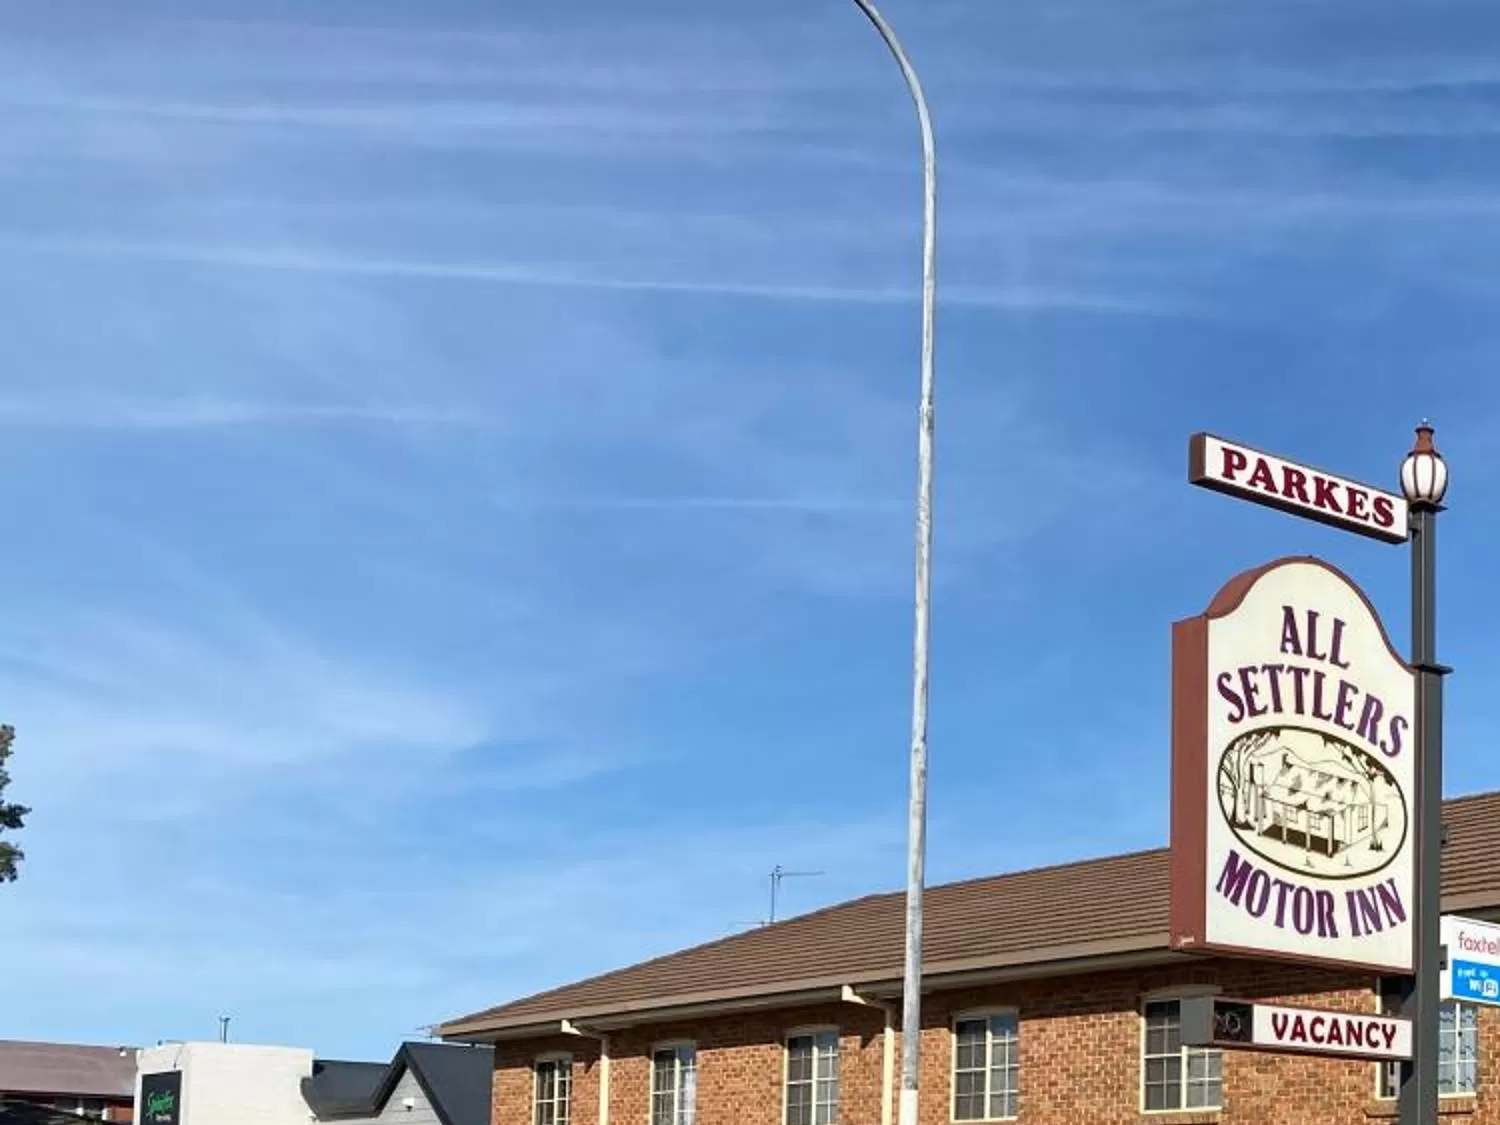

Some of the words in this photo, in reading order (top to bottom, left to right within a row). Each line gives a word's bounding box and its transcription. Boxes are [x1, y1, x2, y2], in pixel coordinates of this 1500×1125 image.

[1220, 446, 1395, 529] PARKES
[1279, 604, 1350, 670] ALL
[1216, 663, 1409, 759] SETTLERS
[1215, 849, 1339, 939] MOTOR
[1344, 877, 1408, 938] INN
[1457, 931, 1500, 956] foxtel
[1271, 1012, 1398, 1049] VACANCY
